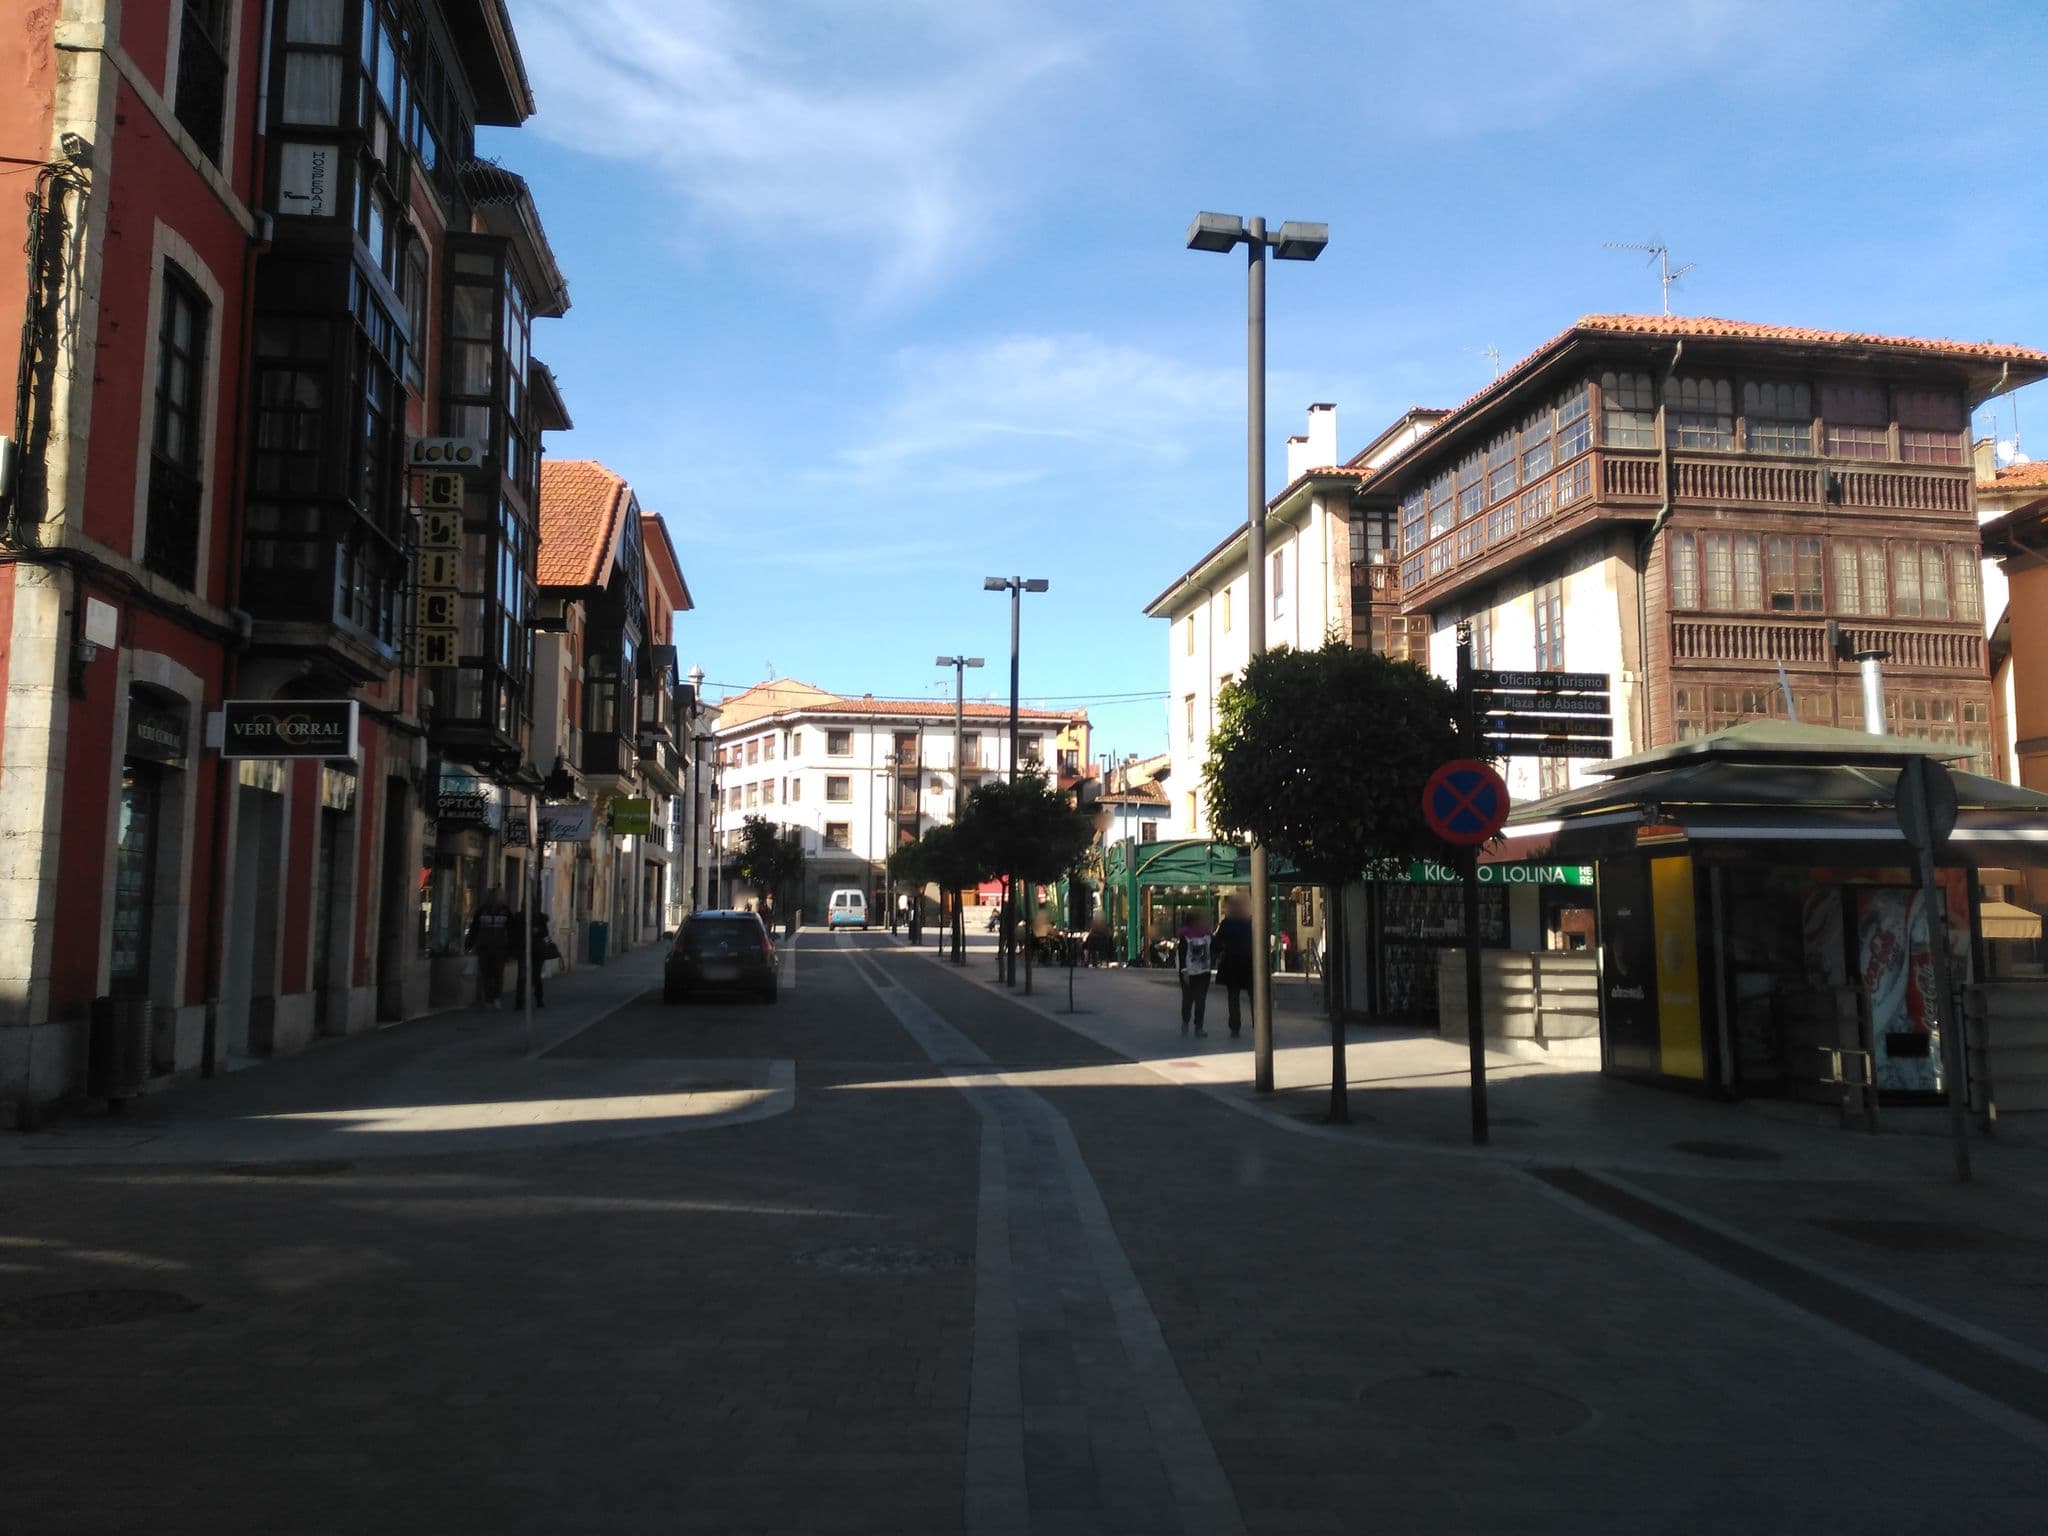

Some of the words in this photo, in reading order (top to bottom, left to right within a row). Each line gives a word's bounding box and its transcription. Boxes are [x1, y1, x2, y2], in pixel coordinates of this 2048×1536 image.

[1499, 672, 1542, 686] Oficina
[1555, 675, 1603, 688] Turismo
[1503, 696, 1535, 708] Plaza
[1537, 698, 1552, 709] de
[1554, 698, 1602, 710] Abastos
[233, 722, 273, 736] VERI
[274, 722, 344, 736] CORRAL
[1538, 741, 1605, 755] Cantábrico
[437, 799, 482, 809] OPTICA
[1502, 866, 1567, 883] LOLINA
